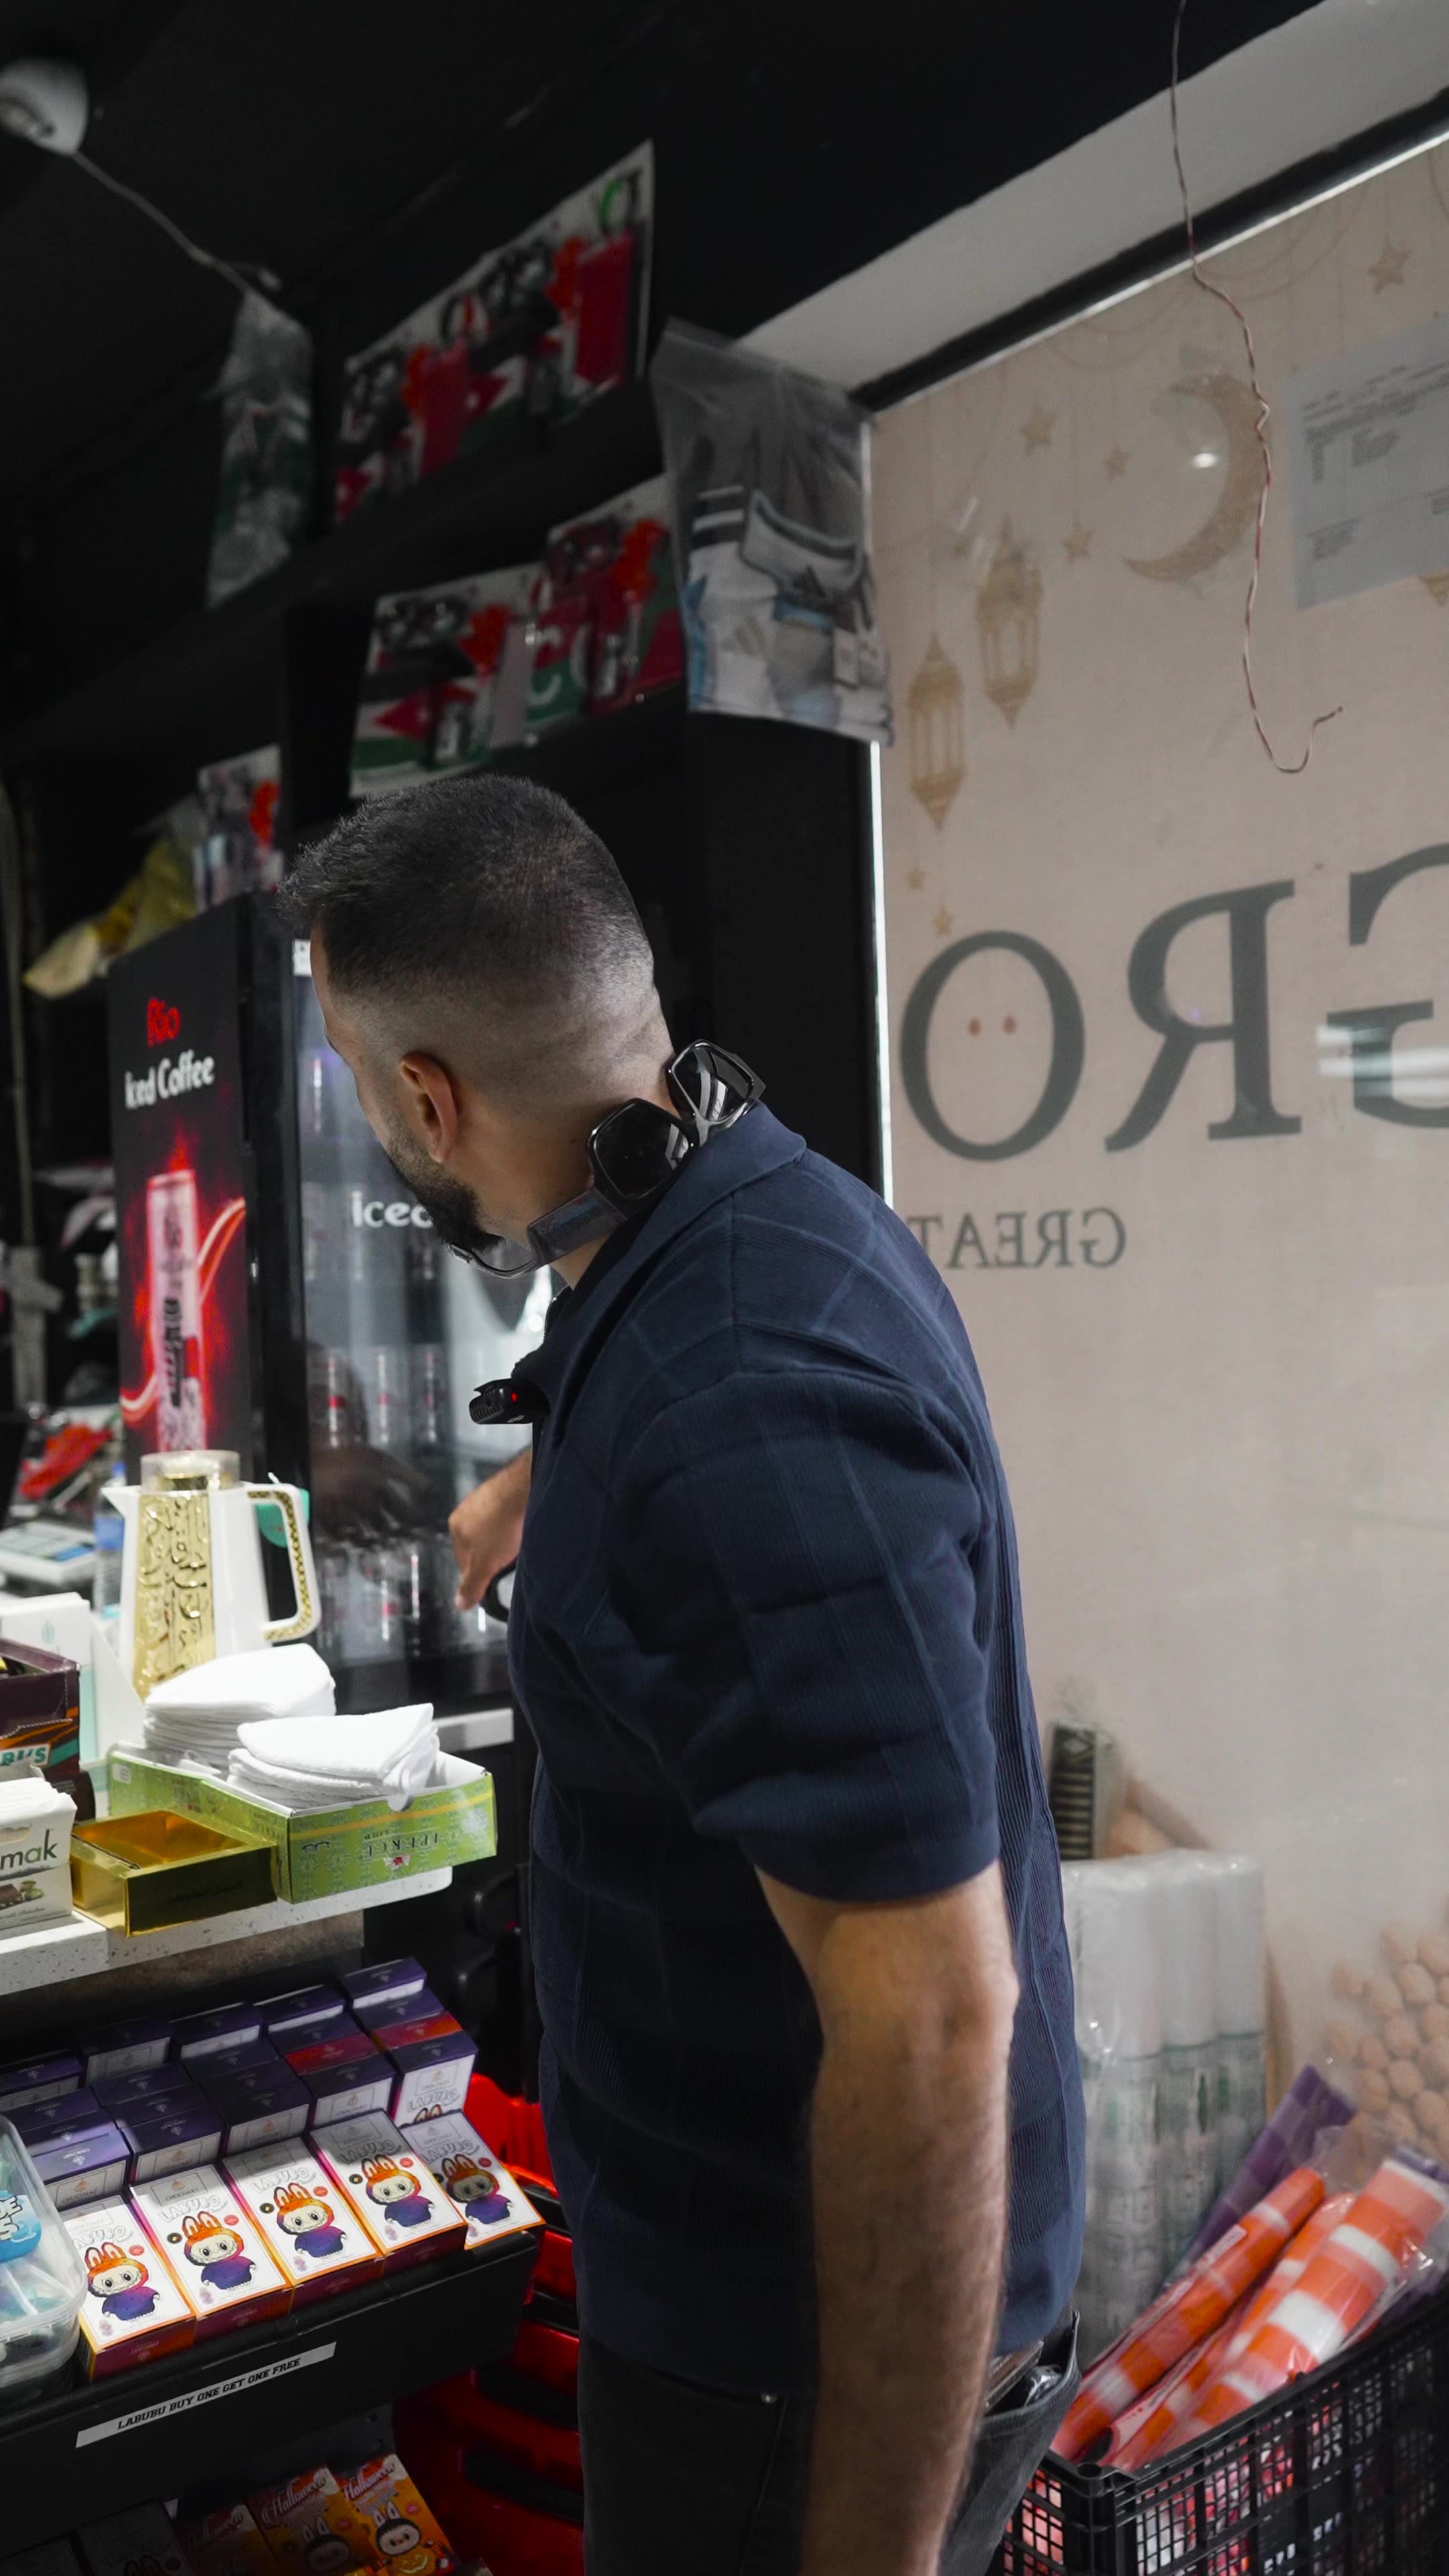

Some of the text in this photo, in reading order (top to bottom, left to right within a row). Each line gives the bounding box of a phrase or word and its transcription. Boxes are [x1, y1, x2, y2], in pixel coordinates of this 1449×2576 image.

[158, 1049, 215, 1099] Coffee
[117, 2357, 301, 2430] LABUBU BUY ONE GET ONE FREE
